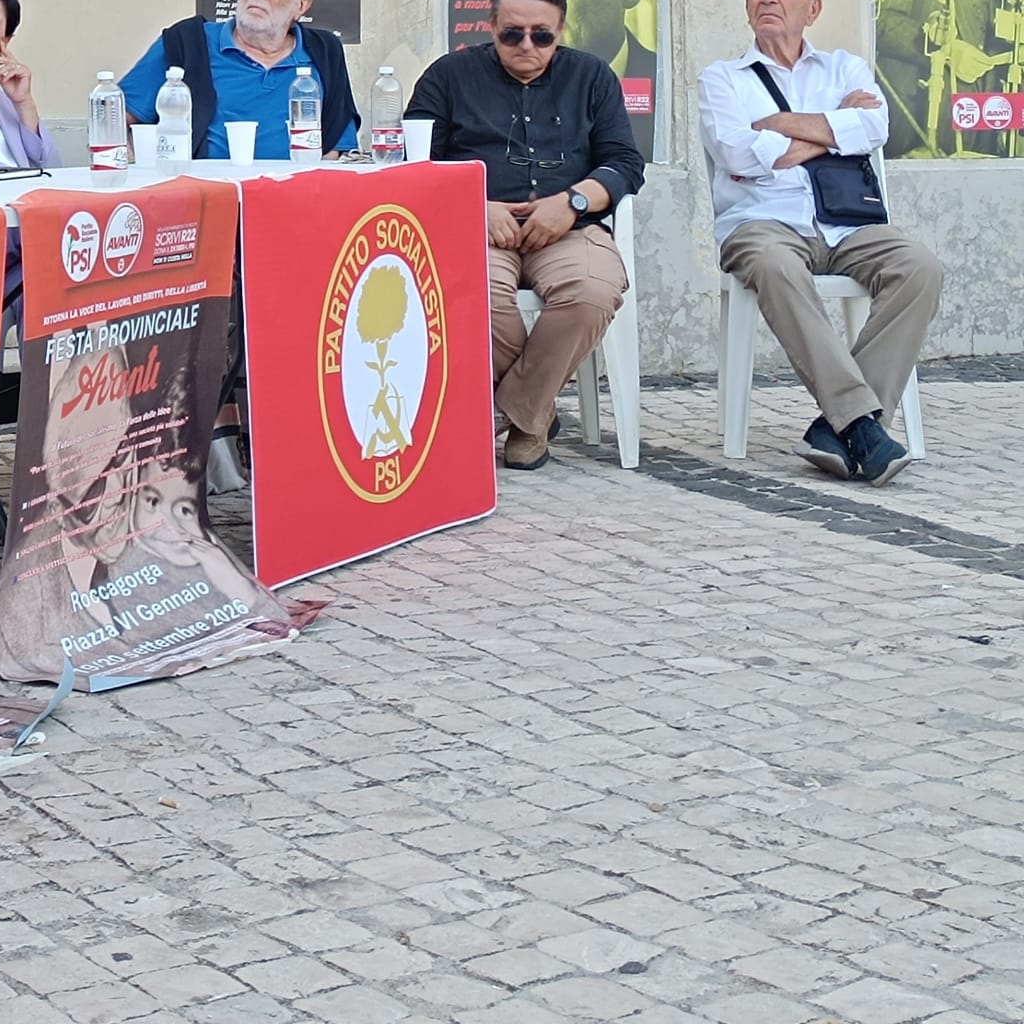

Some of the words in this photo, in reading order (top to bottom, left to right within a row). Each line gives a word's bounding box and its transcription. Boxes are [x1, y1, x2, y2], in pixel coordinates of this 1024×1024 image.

[454, 0, 462, 9] a
[454, 23, 474, 33] per
[958, 113, 975, 124] PSI
[70, 247, 92, 274] PSI
[106, 233, 140, 251] AVANTI
[42, 314, 70, 327] RITORNA
[70, 309, 79, 320] LA
[79, 304, 95, 317] VOCE
[95, 302, 107, 312] DEL
[132, 294, 142, 305] DEI
[164, 285, 185, 297] DELLA
[325, 234, 370, 375] PARTITO
[376, 218, 442, 356] SOCIALISTA
[45, 329, 94, 366] FESTA
[97, 303, 200, 351] PROVINCIALE
[60, 343, 163, 420] Avanti
[375, 456, 401, 492] PSI
[70, 561, 164, 613] Roccagorga
[61, 623, 121, 657] Piazza
[113, 610, 138, 631] VI
[135, 579, 211, 622] Gennaio
[124, 620, 211, 658] settembre
[204, 597, 250, 627] 2026
